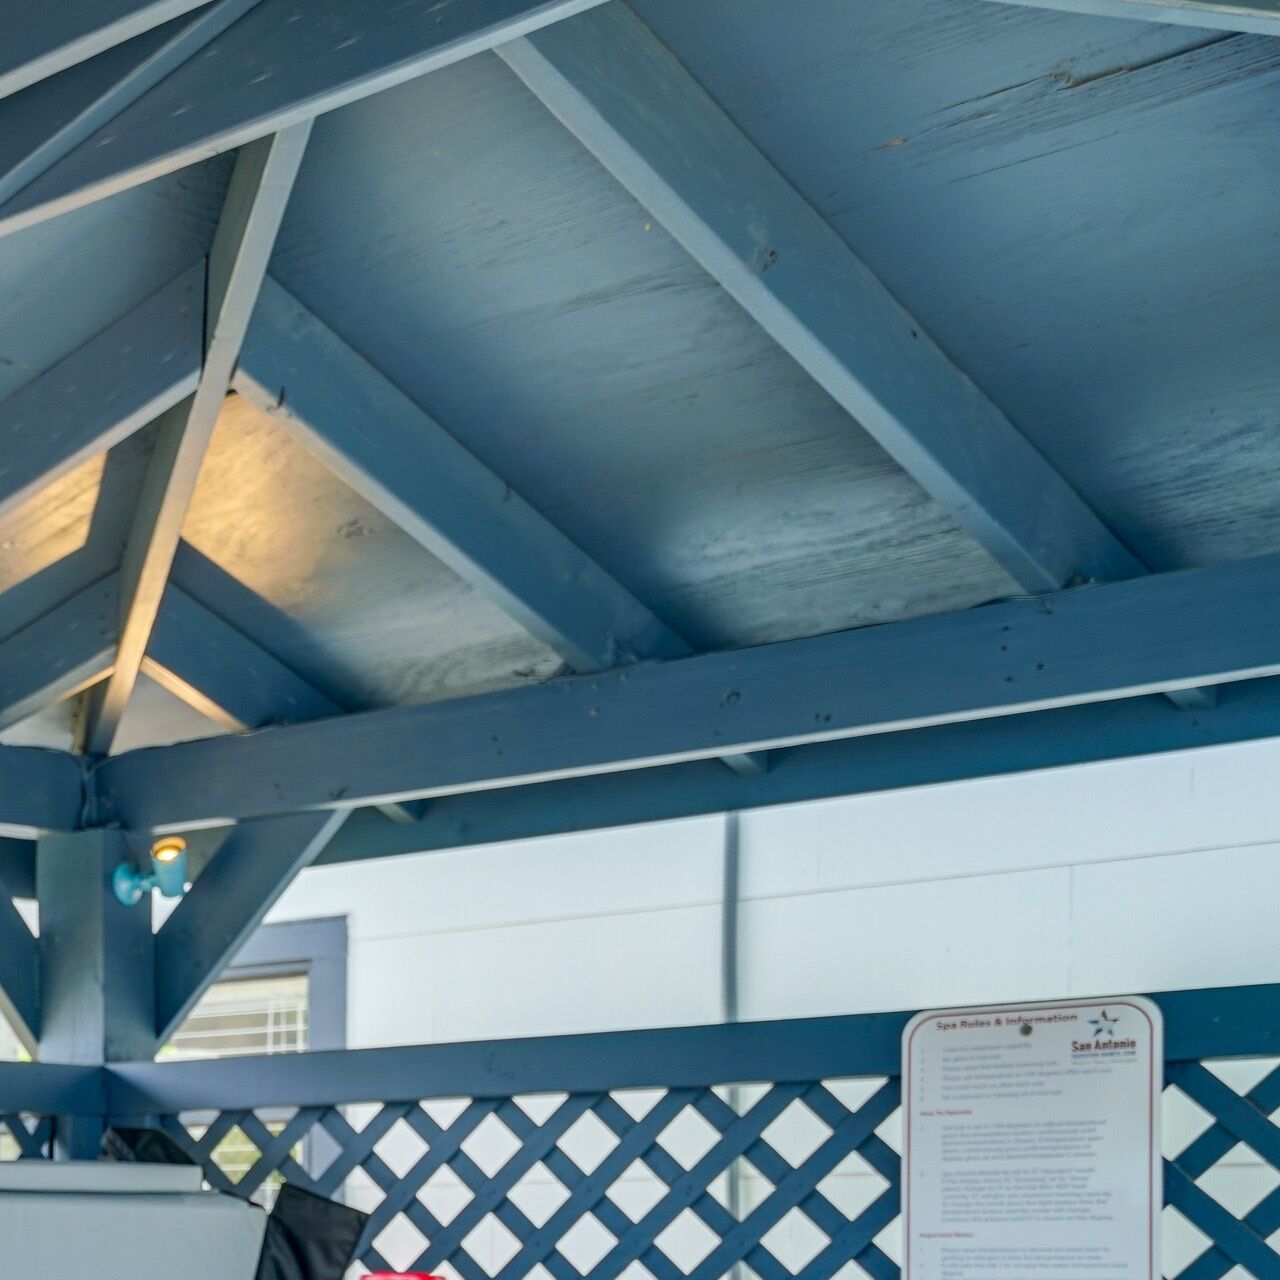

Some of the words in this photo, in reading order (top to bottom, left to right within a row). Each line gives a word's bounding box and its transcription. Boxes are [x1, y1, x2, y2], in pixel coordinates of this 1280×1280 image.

[936, 1021, 957, 1032] Spa
[960, 1018, 992, 1029] Rules
[1072, 1040, 1092, 1053] San
[1094, 1038, 1137, 1051] Antonio
